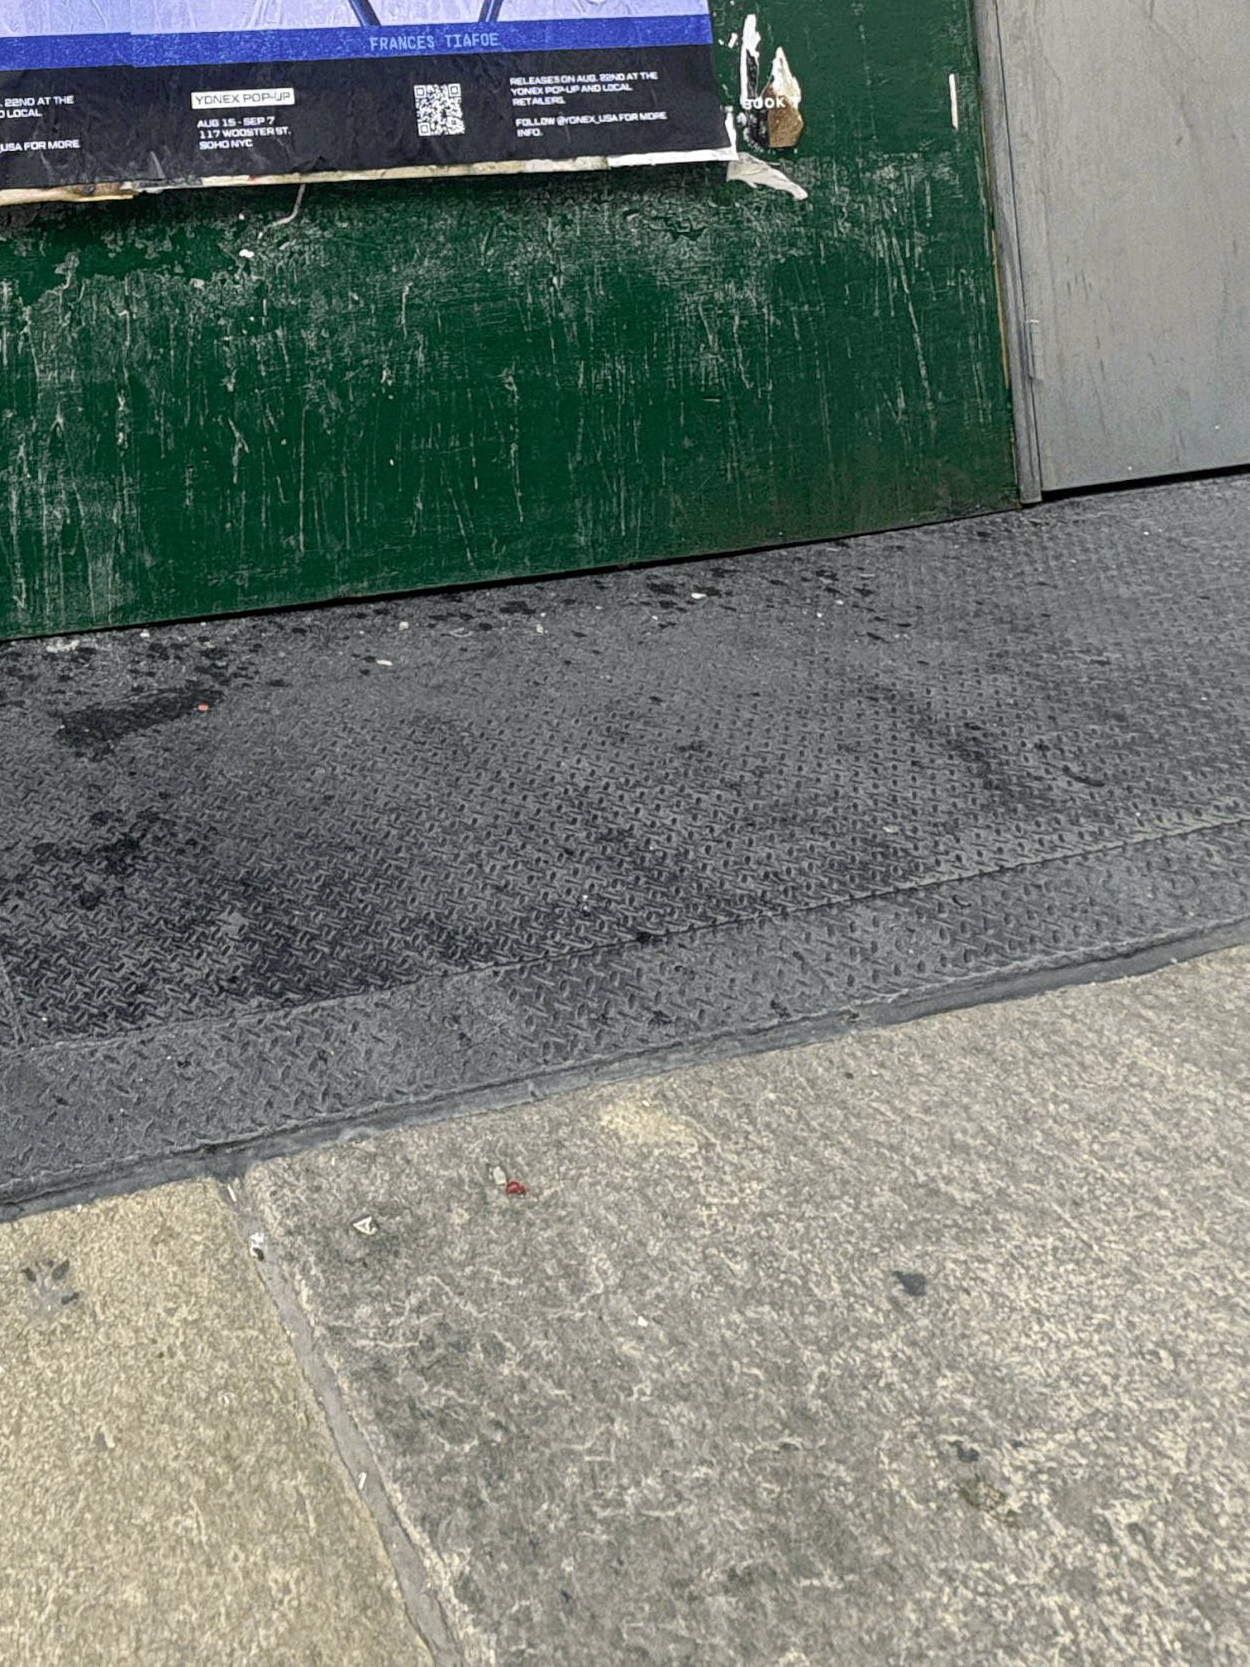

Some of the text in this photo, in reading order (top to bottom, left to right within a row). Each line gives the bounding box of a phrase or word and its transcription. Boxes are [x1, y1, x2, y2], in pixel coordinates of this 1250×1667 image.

[370, 32, 499, 51] FRANCES TIAFOE
[510, 71, 659, 86] RELEASES ON AUG. 22ND AT THE
[511, 82, 634, 96] YONEX POP-UP AND LOCAL
[4, 97, 35, 107] 22ND
[37, 96, 51, 106] AT
[53, 95, 74, 105] THE
[195, 92, 291, 105] YONEX POP-UP
[512, 96, 566, 107] RETAILERS.
[6, 108, 42, 119] LOCAL
[516, 111, 668, 128] FOLLOW @YONEX_USA FOR MORE
[197, 119, 220, 129] AUG
[223, 118, 237, 127] 15
[244, 117, 265, 126] SEP
[267, 116, 276, 126] 7
[200, 127, 292, 140] 117 WOOSTER ST.
[517, 127, 543, 138] INFO.
[24, 141, 47, 151] FOR
[48, 139, 81, 150] MORE
[200, 139, 253, 150] SOHO NYC
